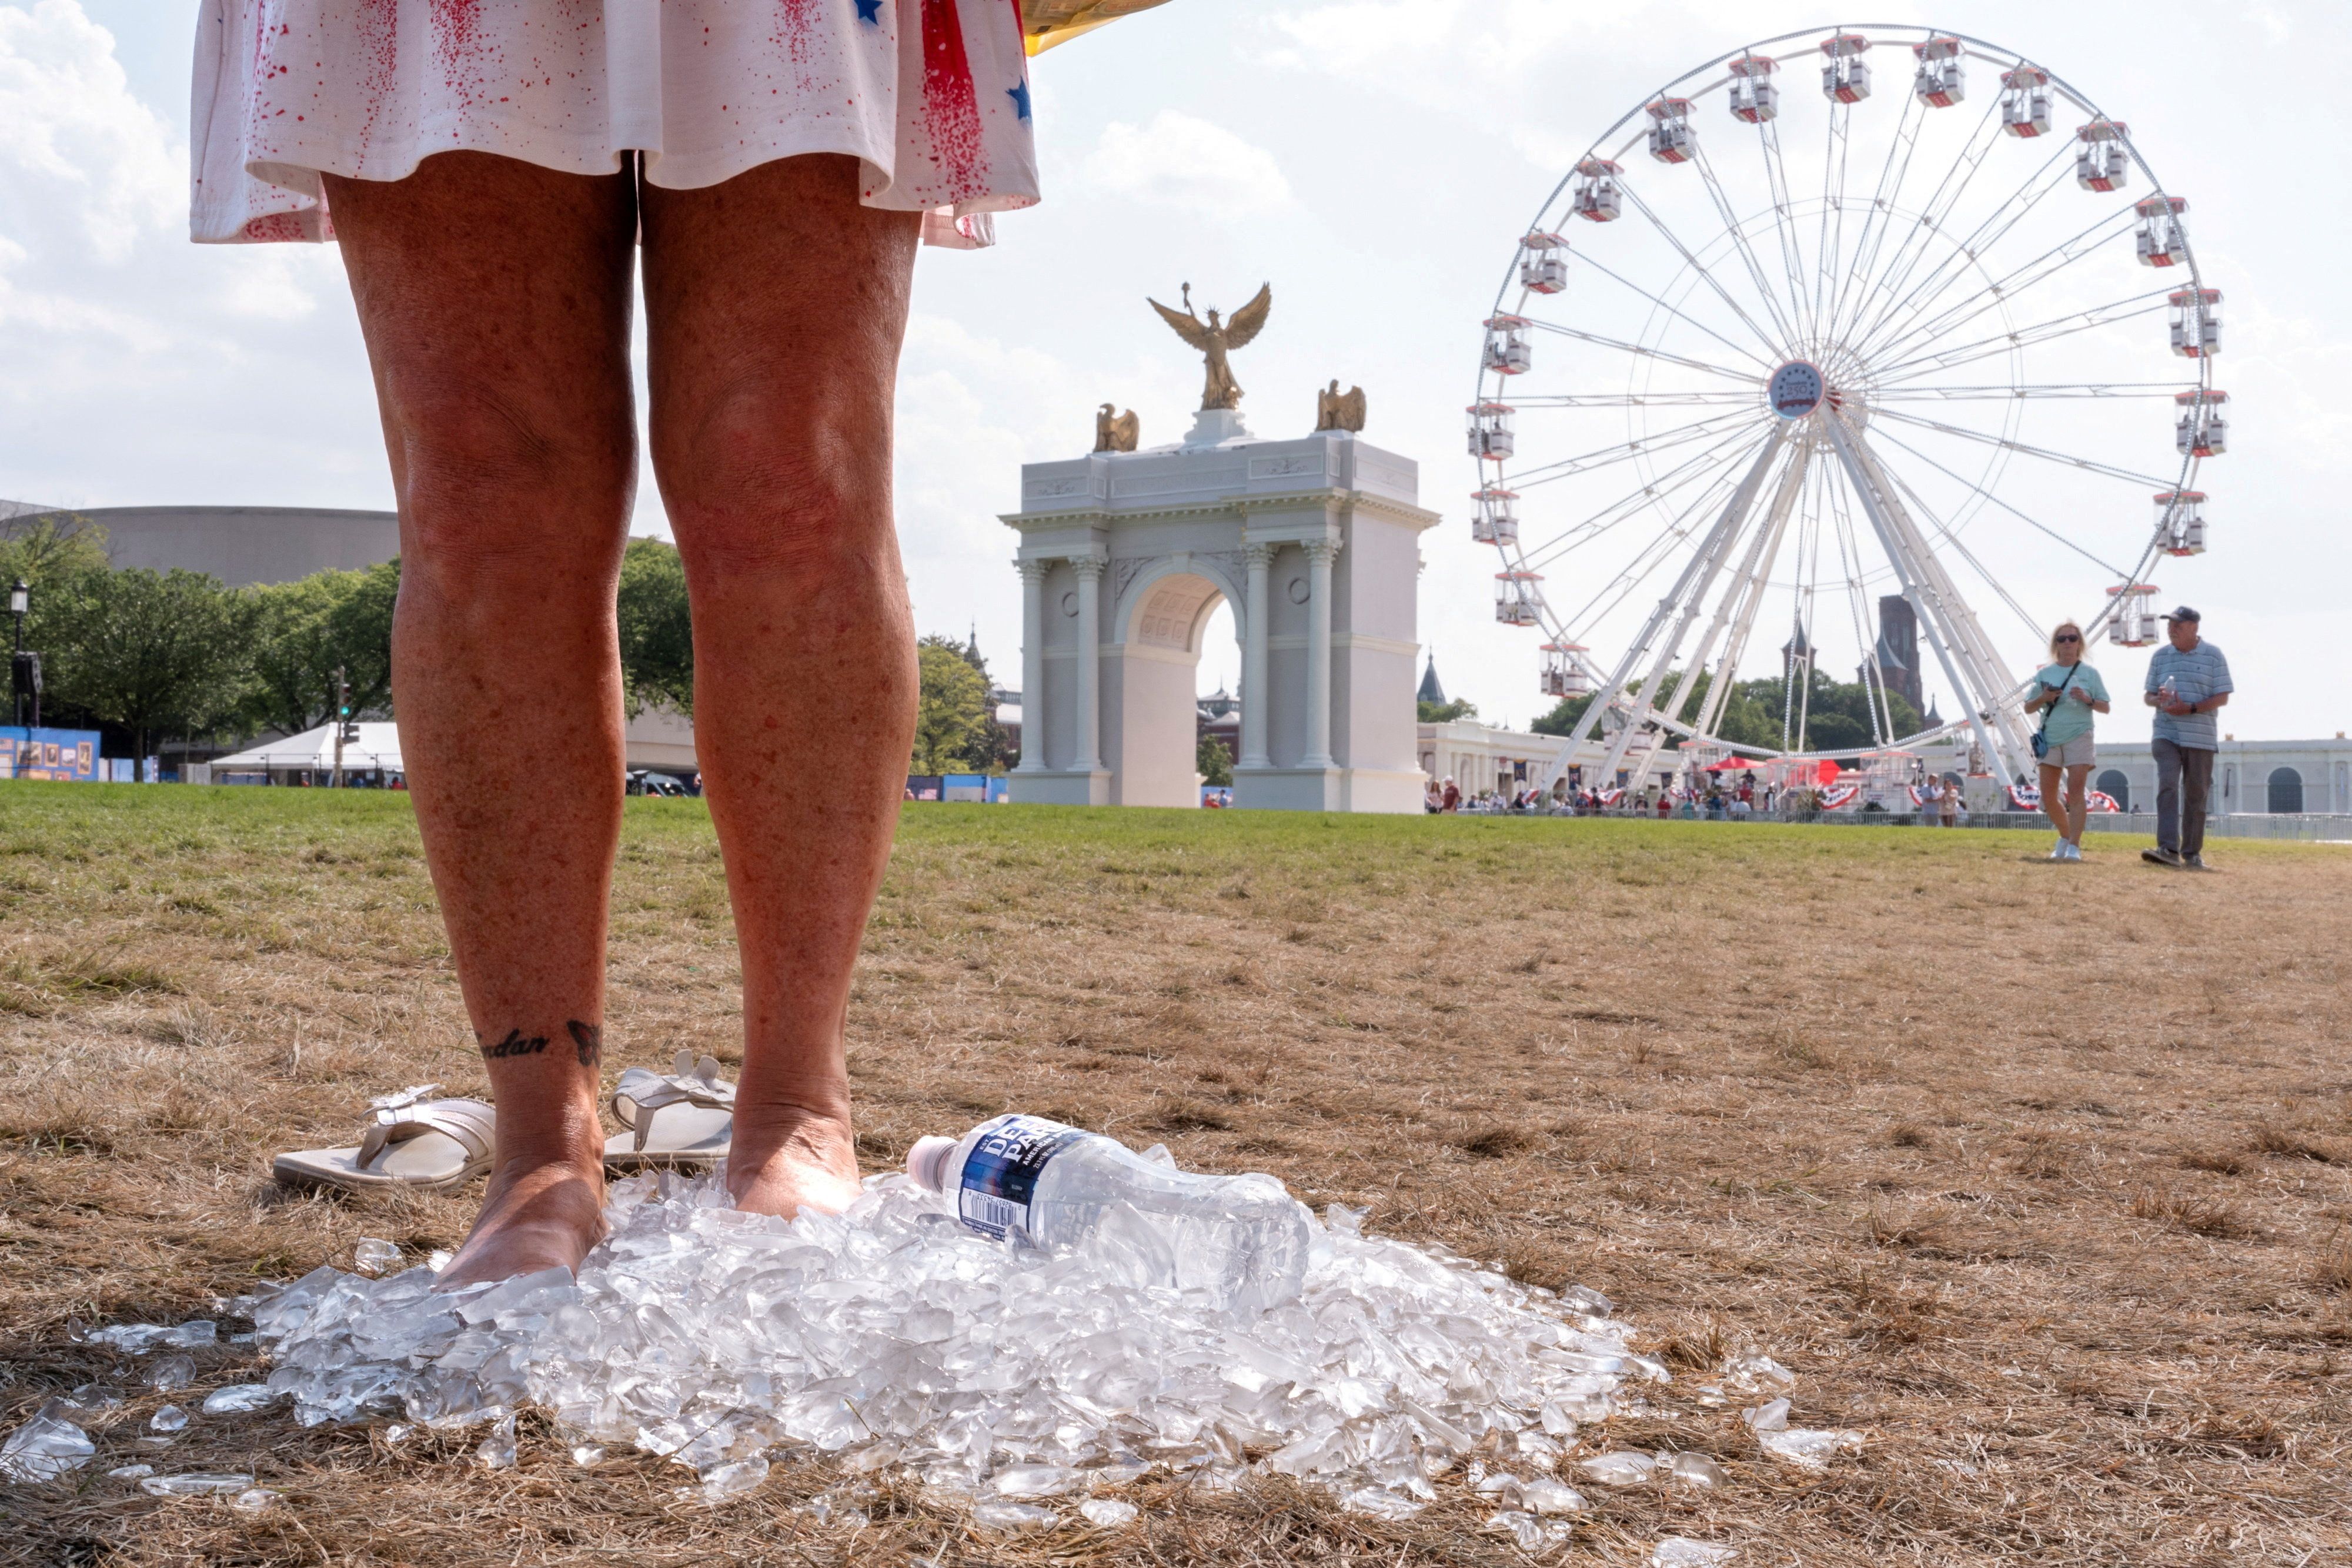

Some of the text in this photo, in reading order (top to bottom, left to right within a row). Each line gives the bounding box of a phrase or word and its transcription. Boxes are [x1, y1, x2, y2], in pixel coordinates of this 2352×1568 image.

[1787, 385, 1807, 399] 250
[983, 1118, 1042, 1158] DEE
[1023, 1136, 1055, 1165] AMERICAN
[977, 1193, 994, 1203] 54333
[995, 1199, 1012, 1210] 82657
